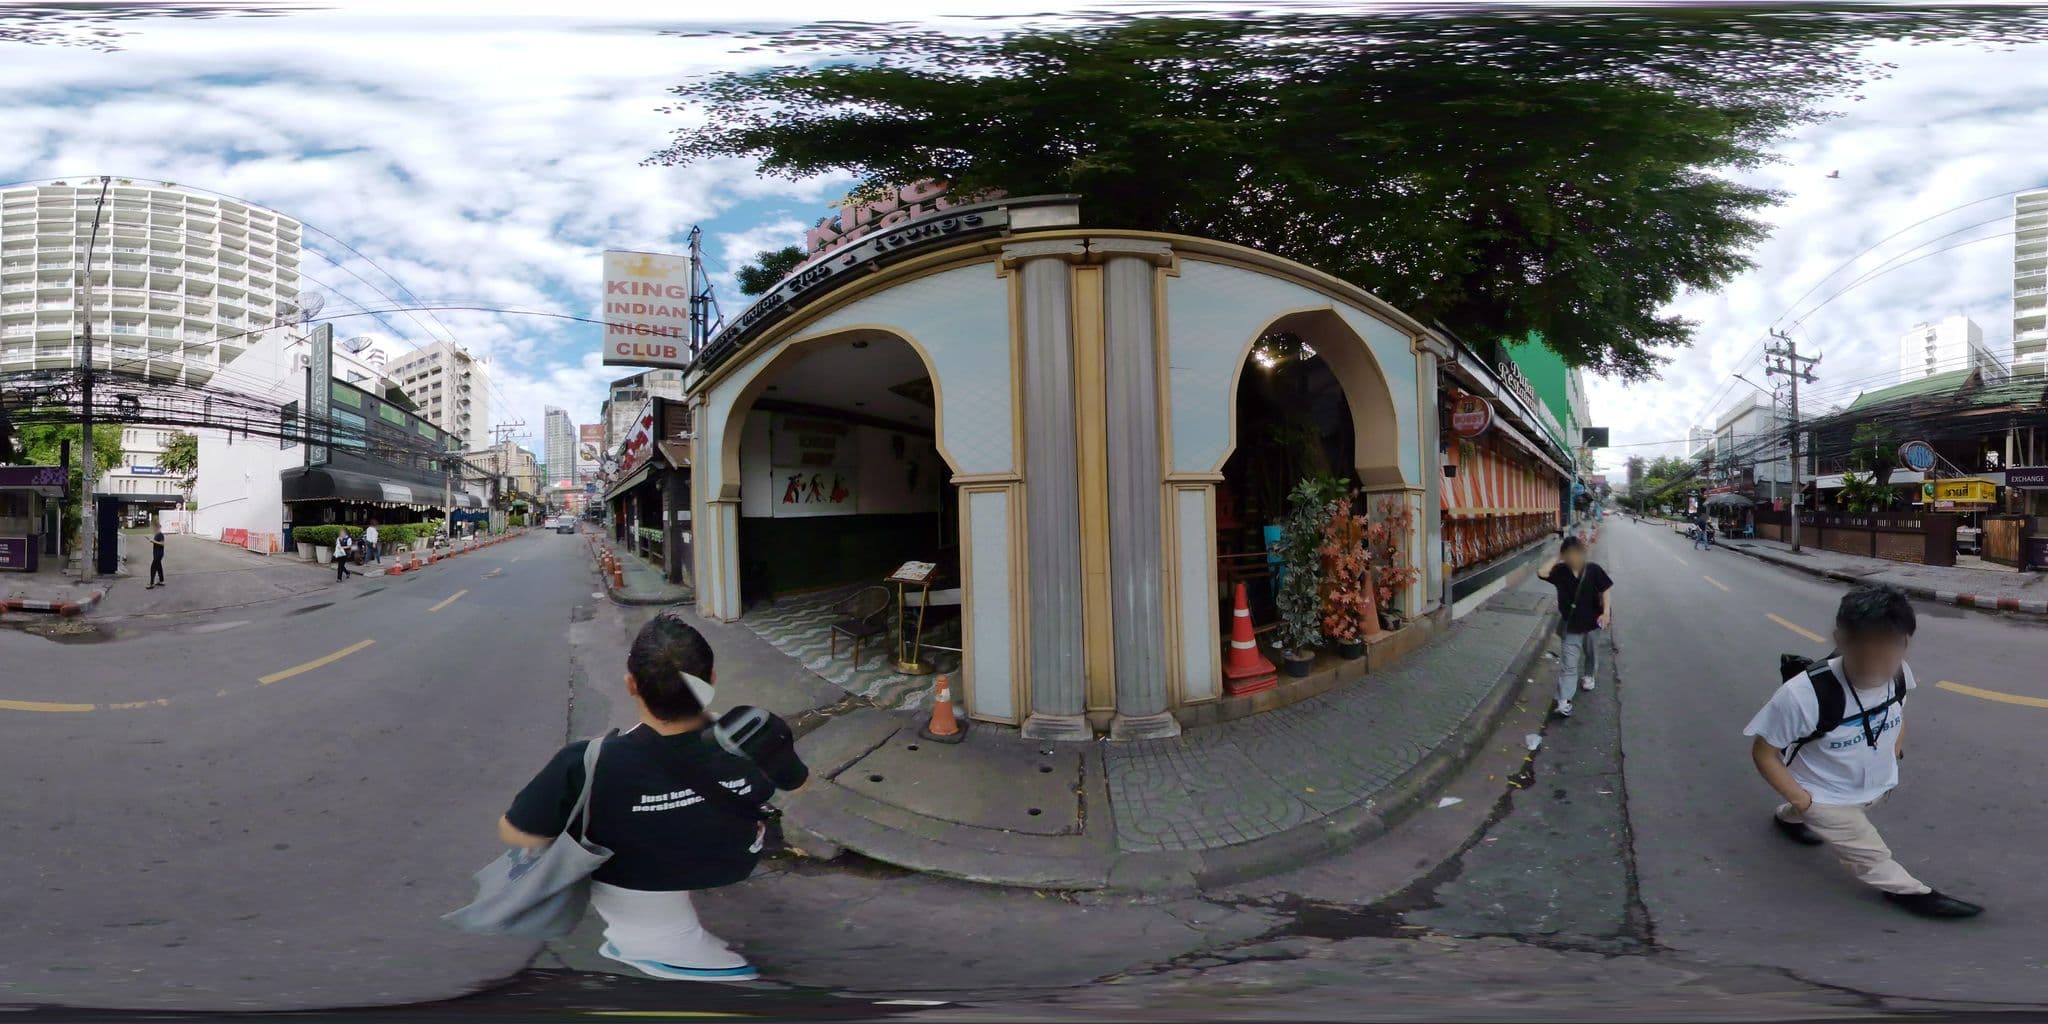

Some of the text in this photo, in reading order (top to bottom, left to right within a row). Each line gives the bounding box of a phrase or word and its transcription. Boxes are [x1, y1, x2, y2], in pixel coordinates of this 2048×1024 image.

[607, 281, 686, 299] KING
[742, 293, 783, 328] Indian
[788, 264, 831, 292] Club
[607, 302, 687, 319] INDIAN
[609, 321, 683, 338] NIGHT
[616, 342, 677, 358] CLUB
[2011, 475, 2045, 483] EXCHANGE
